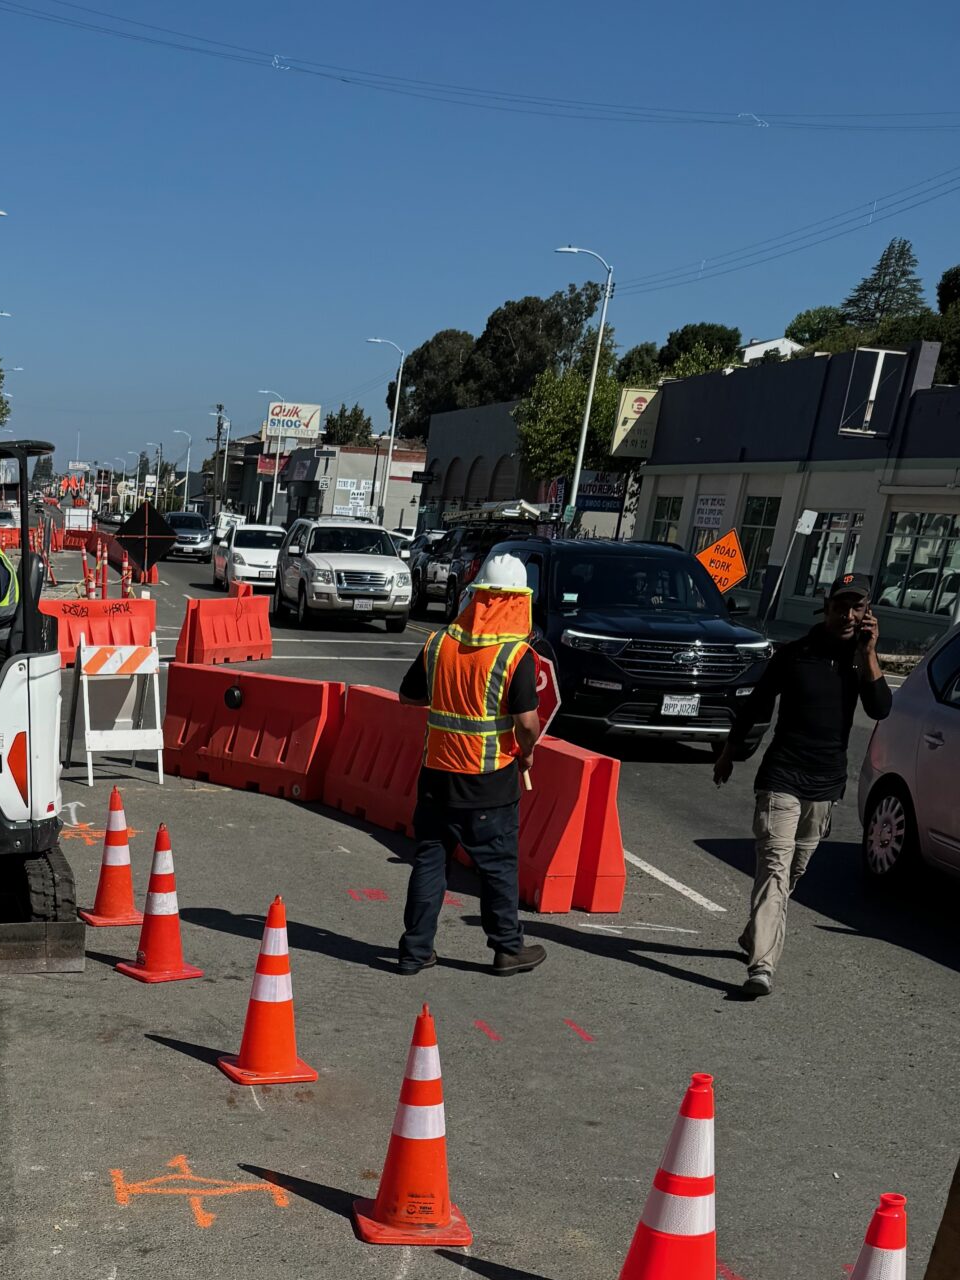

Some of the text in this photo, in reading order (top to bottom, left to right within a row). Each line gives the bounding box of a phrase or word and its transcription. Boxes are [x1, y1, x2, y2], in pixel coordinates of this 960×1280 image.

[271, 404, 302, 418] Quik
[270, 418, 301, 428] SMOG
[714, 544, 737, 558] ROAD
[708, 558, 732, 572] WORK
